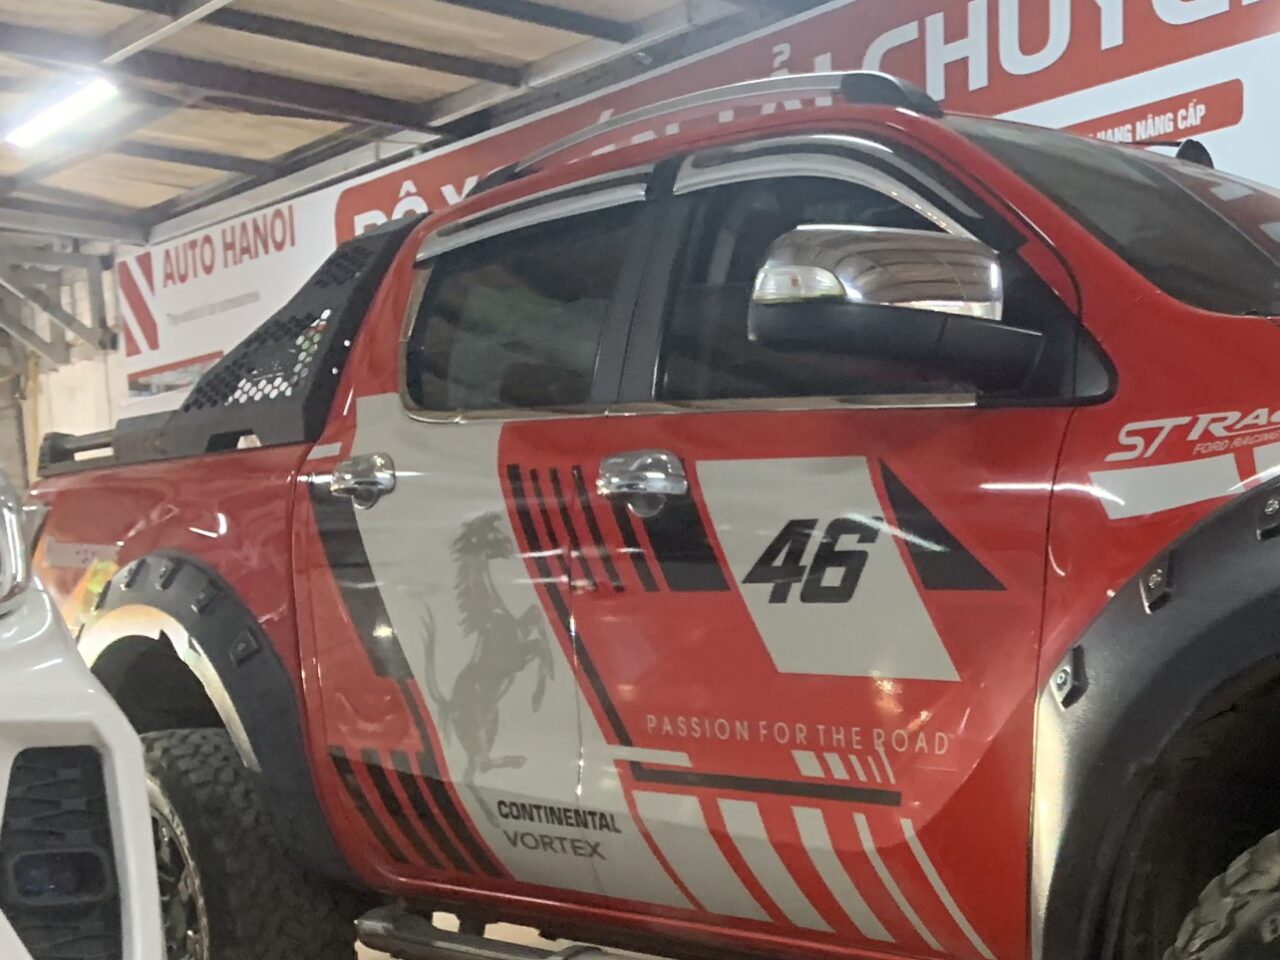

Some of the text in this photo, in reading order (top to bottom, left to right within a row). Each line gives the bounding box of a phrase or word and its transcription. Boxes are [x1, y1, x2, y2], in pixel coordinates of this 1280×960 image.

[163, 204, 296, 288] AUTO HANOI
[1104, 415, 1192, 462] ST
[1192, 440, 1229, 455] FORD
[741, 516, 883, 605] 46
[646, 714, 949, 756] PASSION FOR THE ROAD
[497, 800, 623, 834] CONTINENTAL
[503, 829, 608, 861] VORTEX
